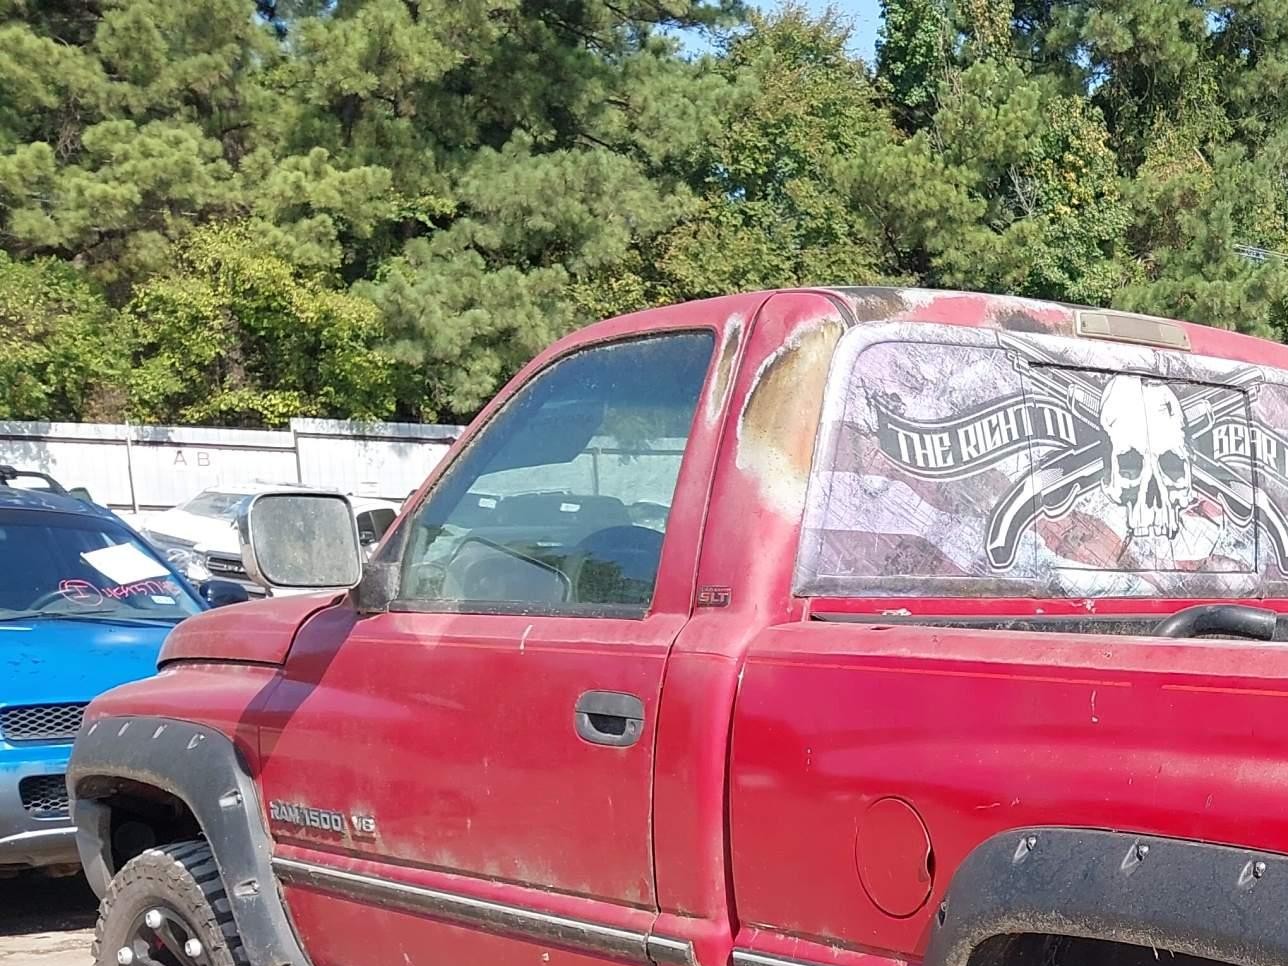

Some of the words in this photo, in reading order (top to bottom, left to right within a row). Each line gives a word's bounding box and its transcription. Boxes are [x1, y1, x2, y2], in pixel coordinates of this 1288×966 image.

[888, 423, 955, 468] THE
[957, 403, 1035, 463] RIGHT
[1036, 403, 1077, 446] TO
[1212, 423, 1278, 470] BEAR
[699, 592, 729, 602] SLT
[270, 800, 300, 824] RAM
[303, 808, 344, 833] 1500
